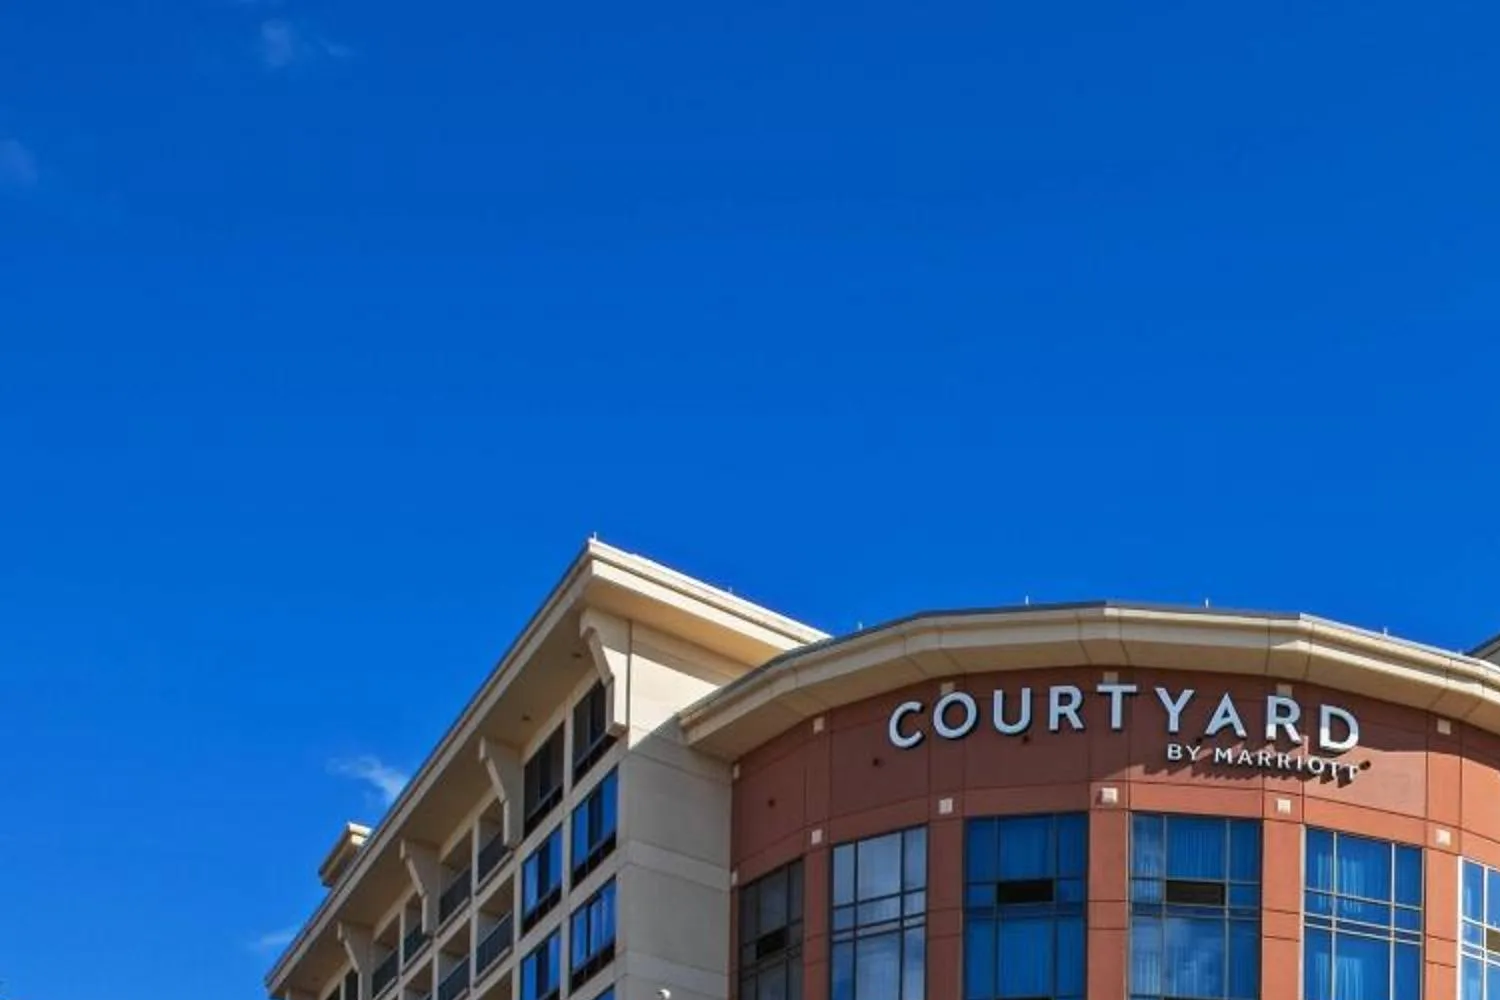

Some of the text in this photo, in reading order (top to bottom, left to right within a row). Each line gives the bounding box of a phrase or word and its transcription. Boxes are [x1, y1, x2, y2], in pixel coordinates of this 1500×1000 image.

[888, 683, 1360, 752] COURTYARD
[1167, 743, 1360, 780] BY MARRIOTT
